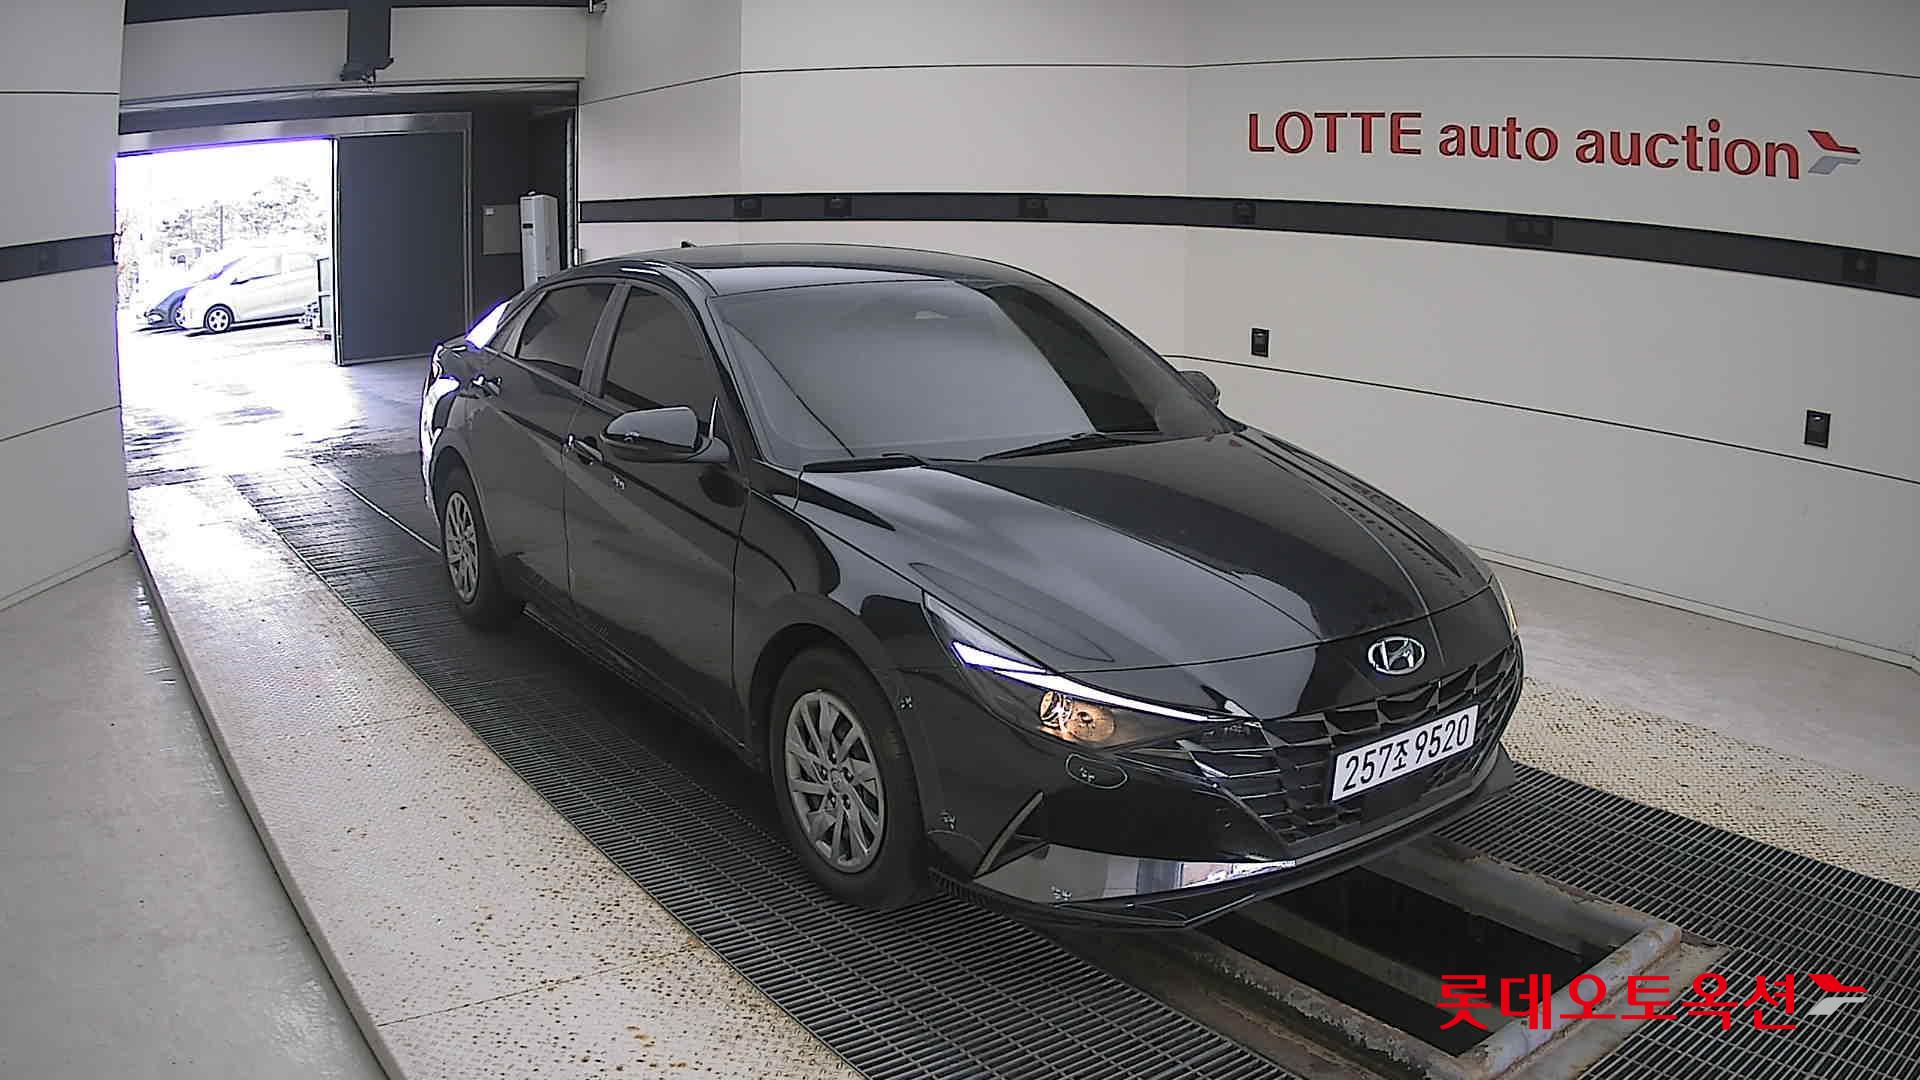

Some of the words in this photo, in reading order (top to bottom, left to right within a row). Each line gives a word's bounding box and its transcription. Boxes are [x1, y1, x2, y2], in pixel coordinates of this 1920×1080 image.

[1248, 111, 1422, 154] LOTTE
[1439, 118, 1559, 161] auto
[1576, 119, 1800, 179] auction
[1415, 715, 1469, 764] 9520
